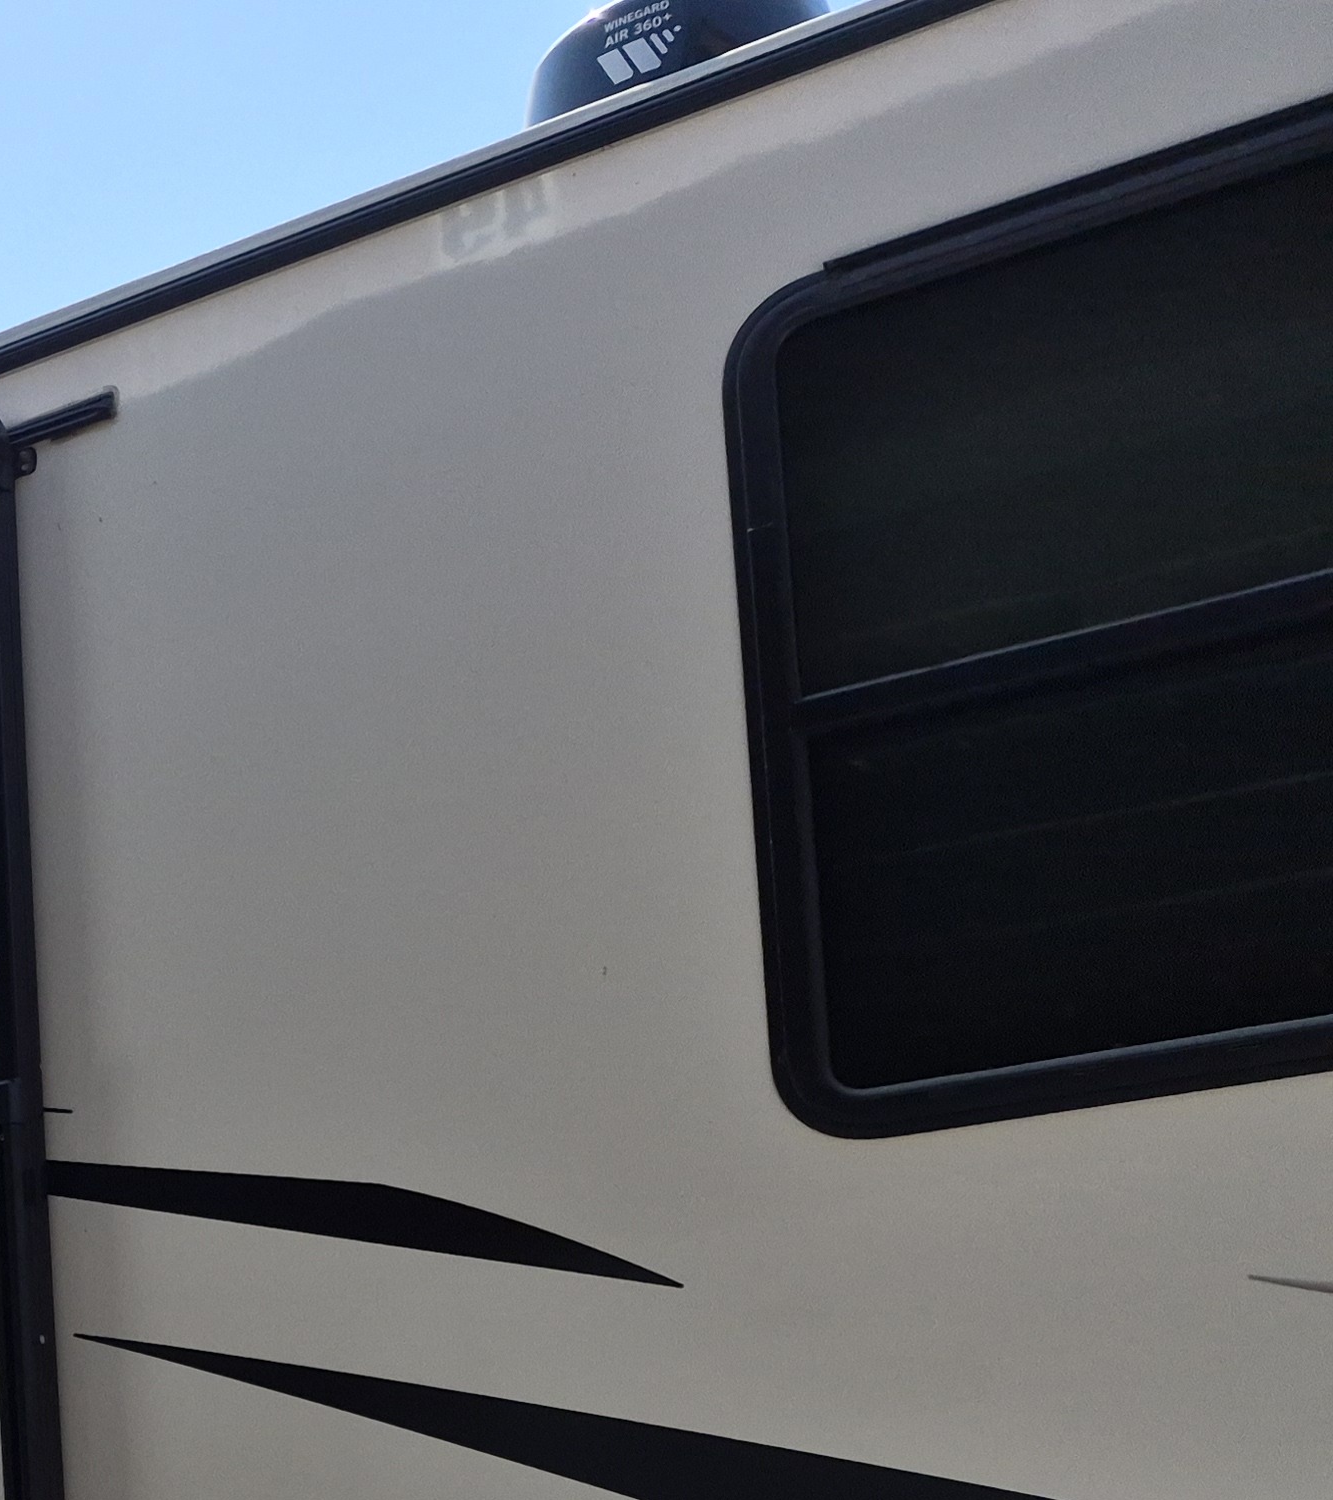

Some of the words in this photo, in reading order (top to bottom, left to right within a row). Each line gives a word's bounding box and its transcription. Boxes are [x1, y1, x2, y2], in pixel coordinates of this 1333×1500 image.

[604, 0, 670, 33] WINEGARD
[604, 28, 629, 49] AIR
[633, 12, 673, 35] 360+
